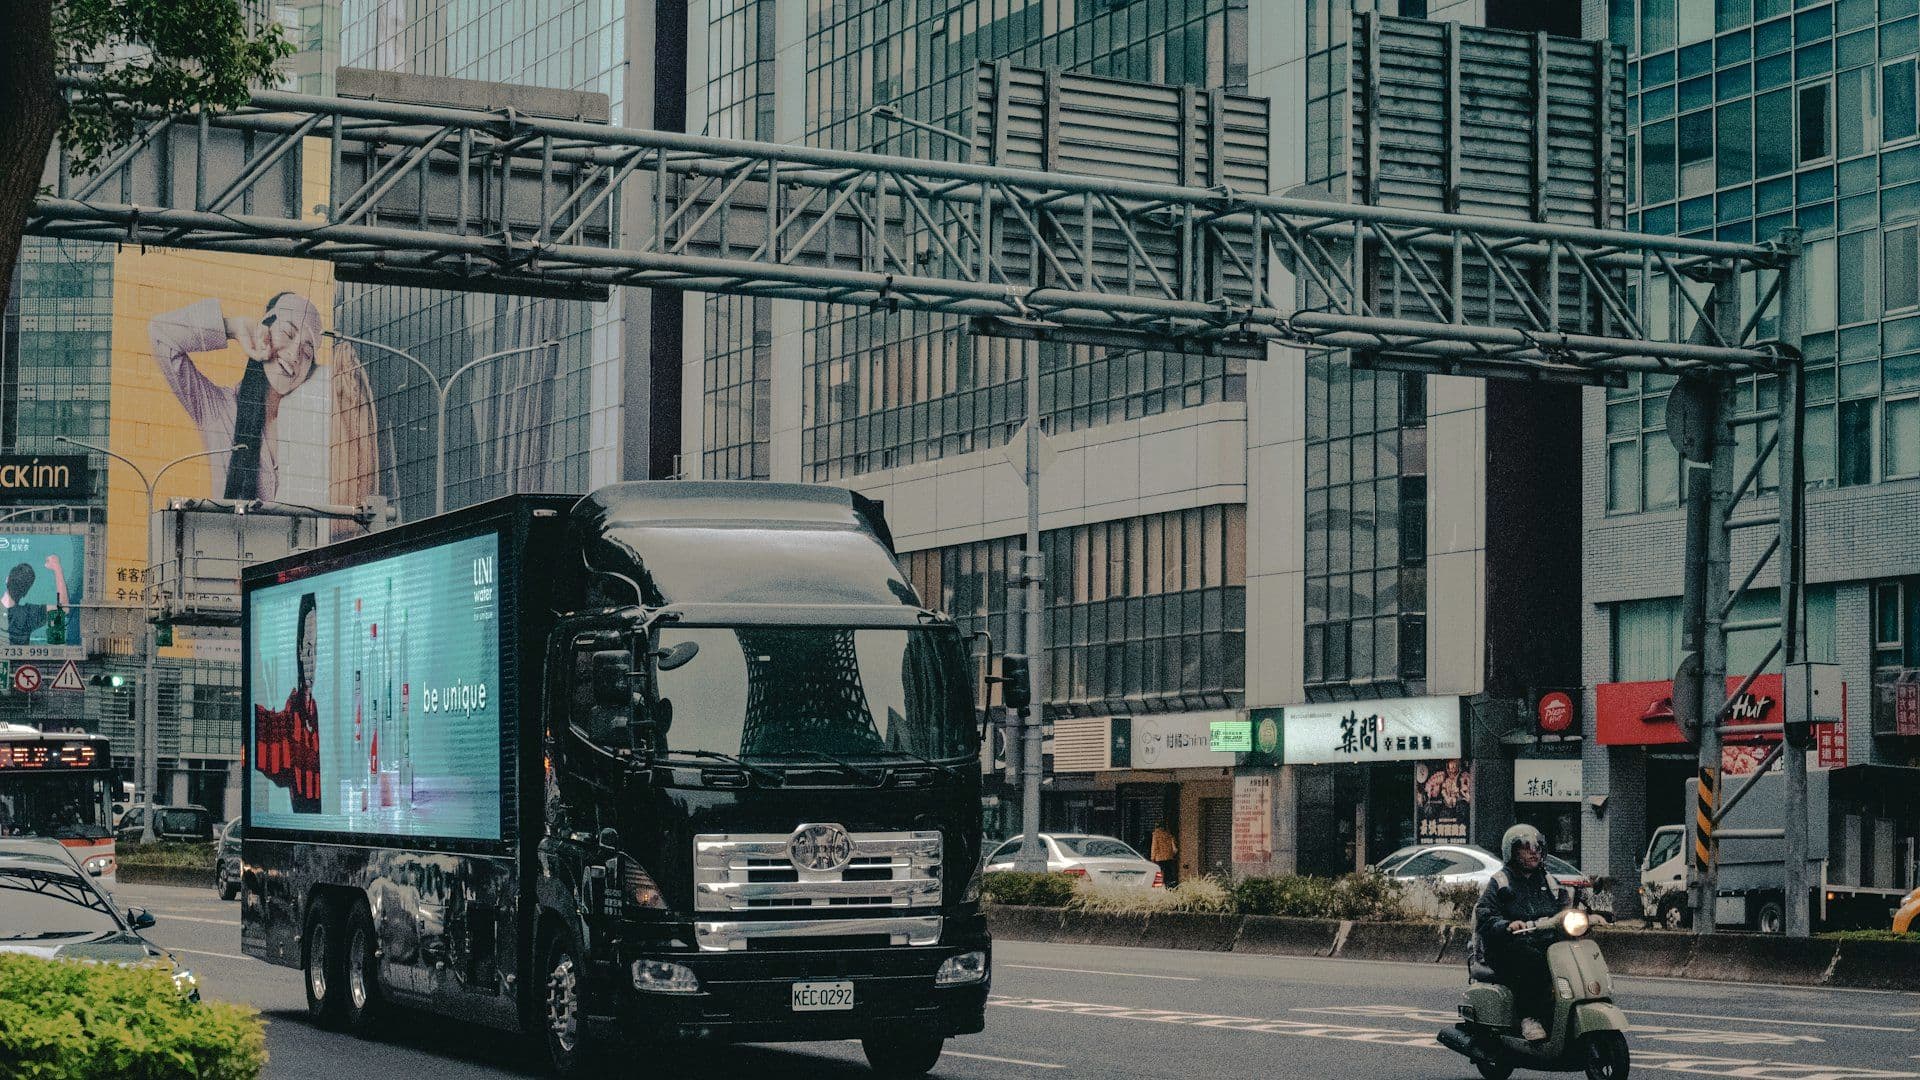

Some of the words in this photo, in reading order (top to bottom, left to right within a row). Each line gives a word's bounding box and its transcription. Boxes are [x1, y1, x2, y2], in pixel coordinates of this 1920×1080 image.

[0, 464, 30, 488] CK
[32, 457, 69, 488] inn
[473, 556, 493, 586] UNI
[473, 586, 493, 603] water
[423, 681, 438, 713] be
[443, 677, 487, 718] unique
[1732, 694, 1770, 720] Hut
[794, 989, 852, 1006] KEC-0292
